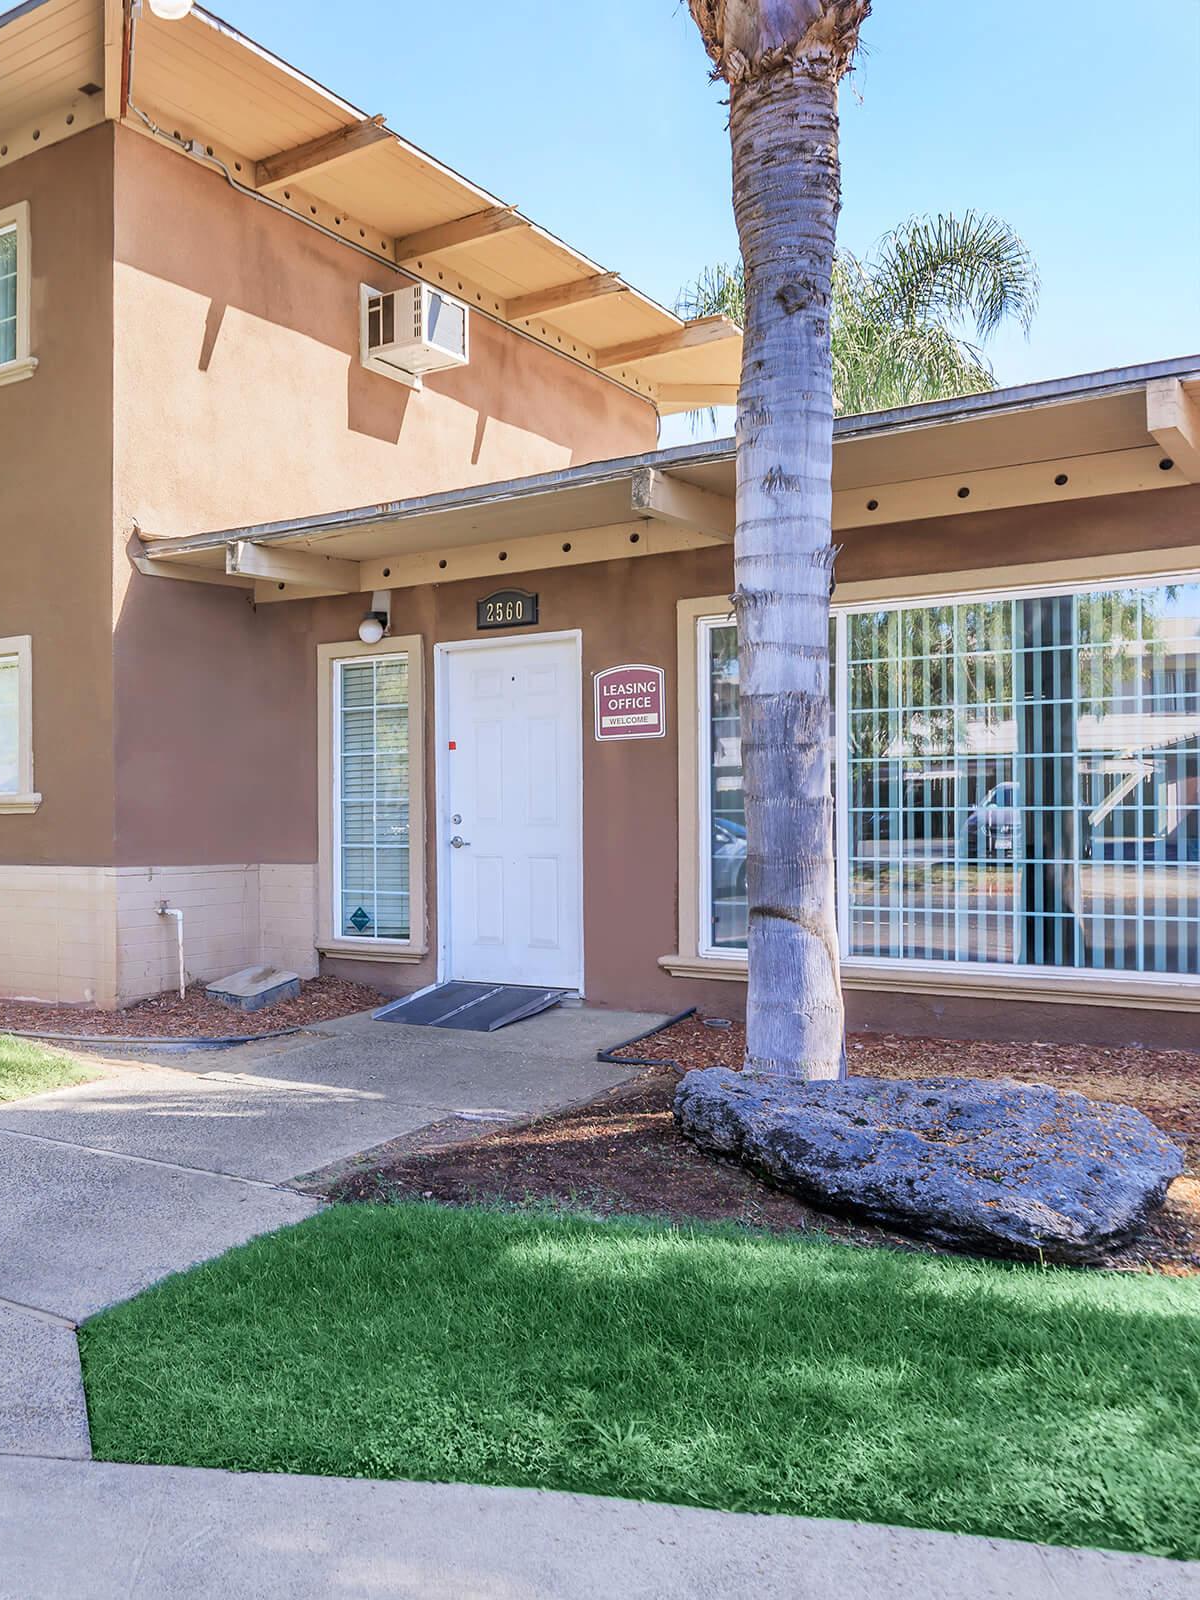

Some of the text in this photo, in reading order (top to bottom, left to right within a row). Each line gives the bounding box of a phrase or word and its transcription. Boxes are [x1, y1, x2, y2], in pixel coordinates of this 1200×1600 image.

[486, 600, 523, 622] 2560
[603, 681, 656, 697] LEASING
[608, 696, 652, 711] OFFICE
[609, 715, 649, 725] WELCOME
